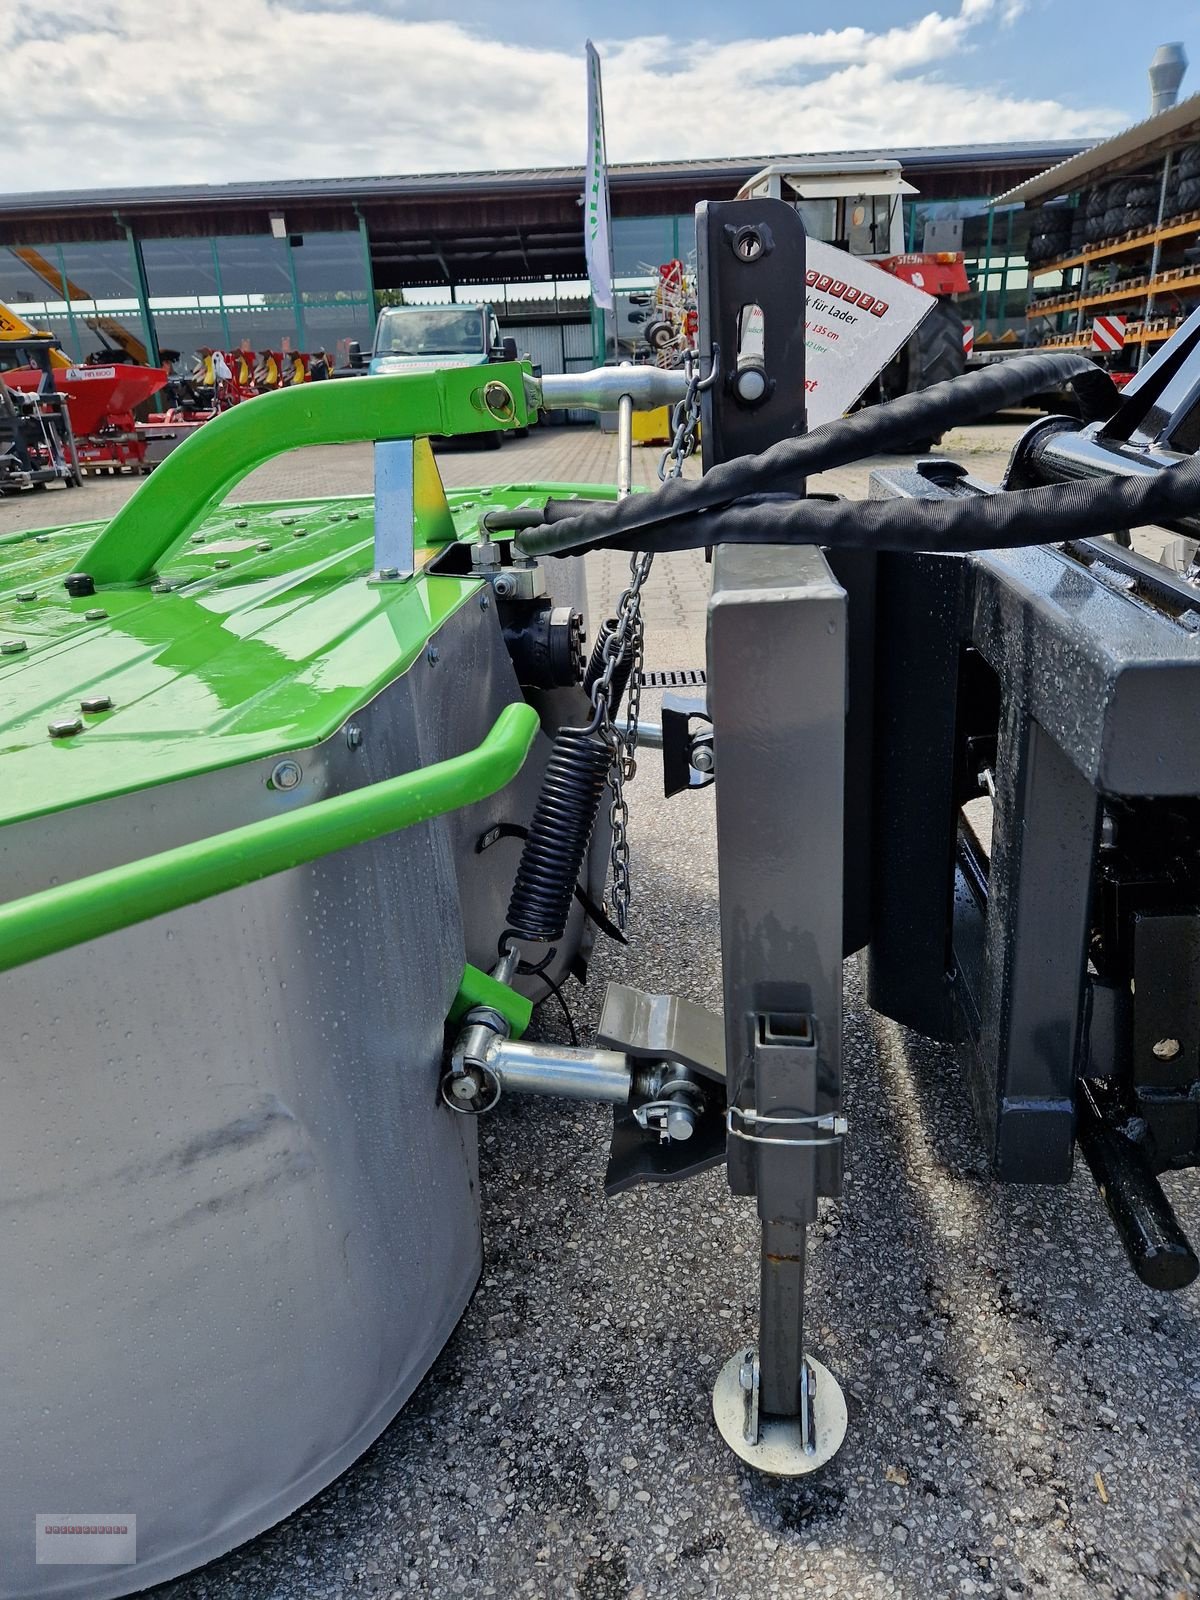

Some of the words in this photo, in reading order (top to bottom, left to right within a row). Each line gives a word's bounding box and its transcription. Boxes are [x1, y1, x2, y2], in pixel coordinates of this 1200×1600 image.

[811, 299, 828, 312] für
[828, 305, 858, 324] Lader
[812, 324, 827, 335] 135
[827, 331, 839, 340] cm
